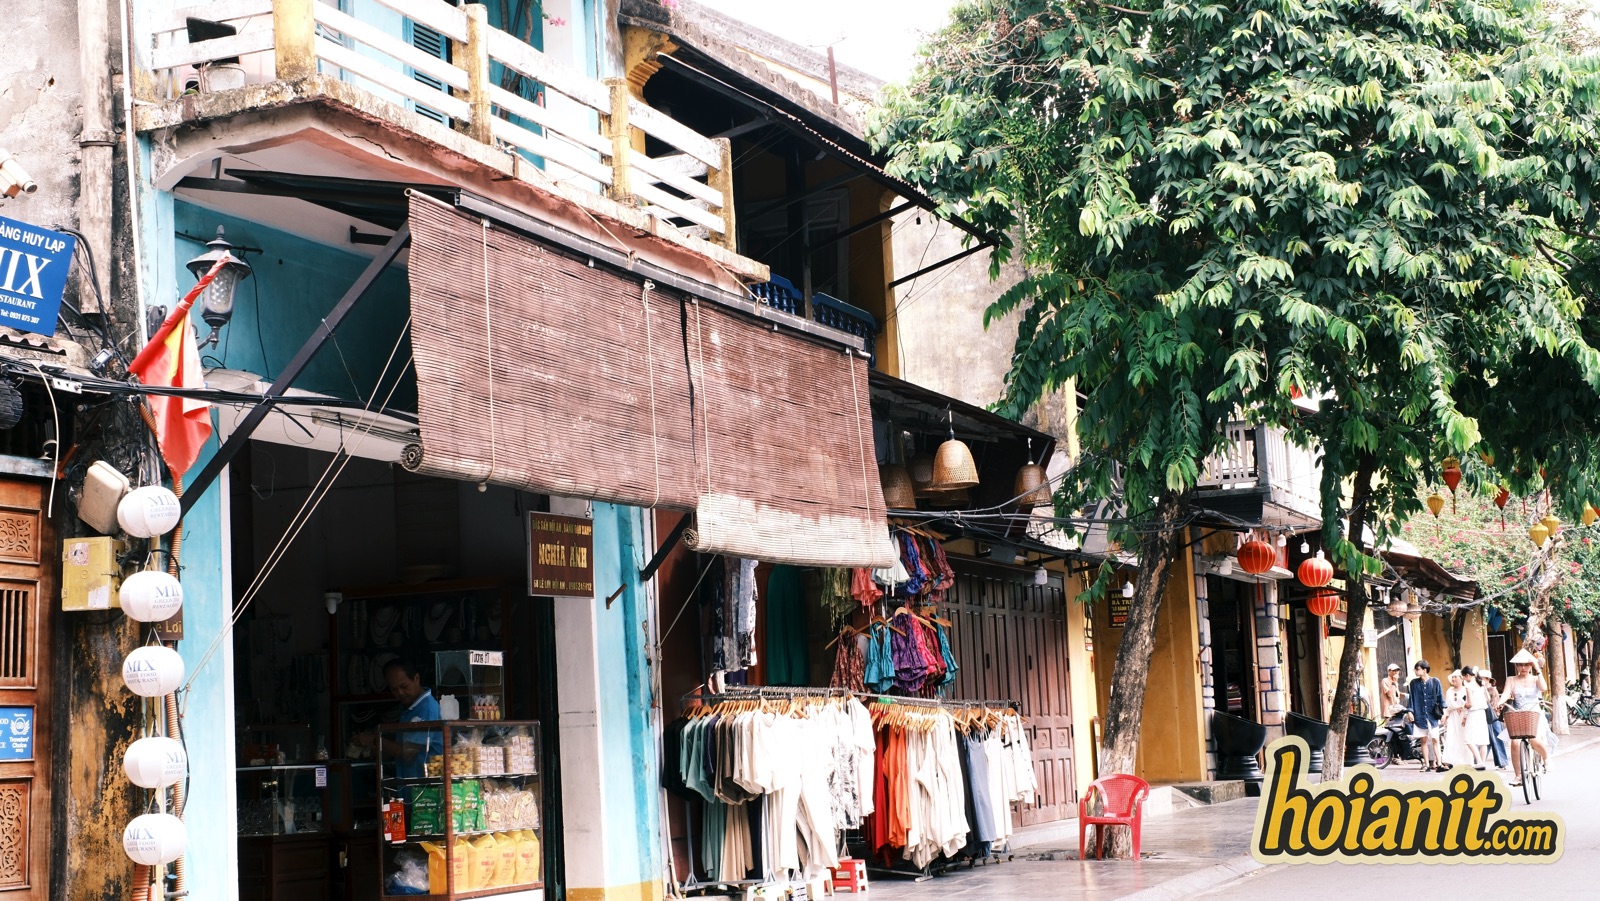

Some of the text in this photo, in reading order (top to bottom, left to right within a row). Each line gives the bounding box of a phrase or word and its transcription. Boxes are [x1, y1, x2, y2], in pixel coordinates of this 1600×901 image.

[22, 231, 45, 247] HUY
[126, 660, 156, 673] MIX
[126, 828, 154, 840] MIX
